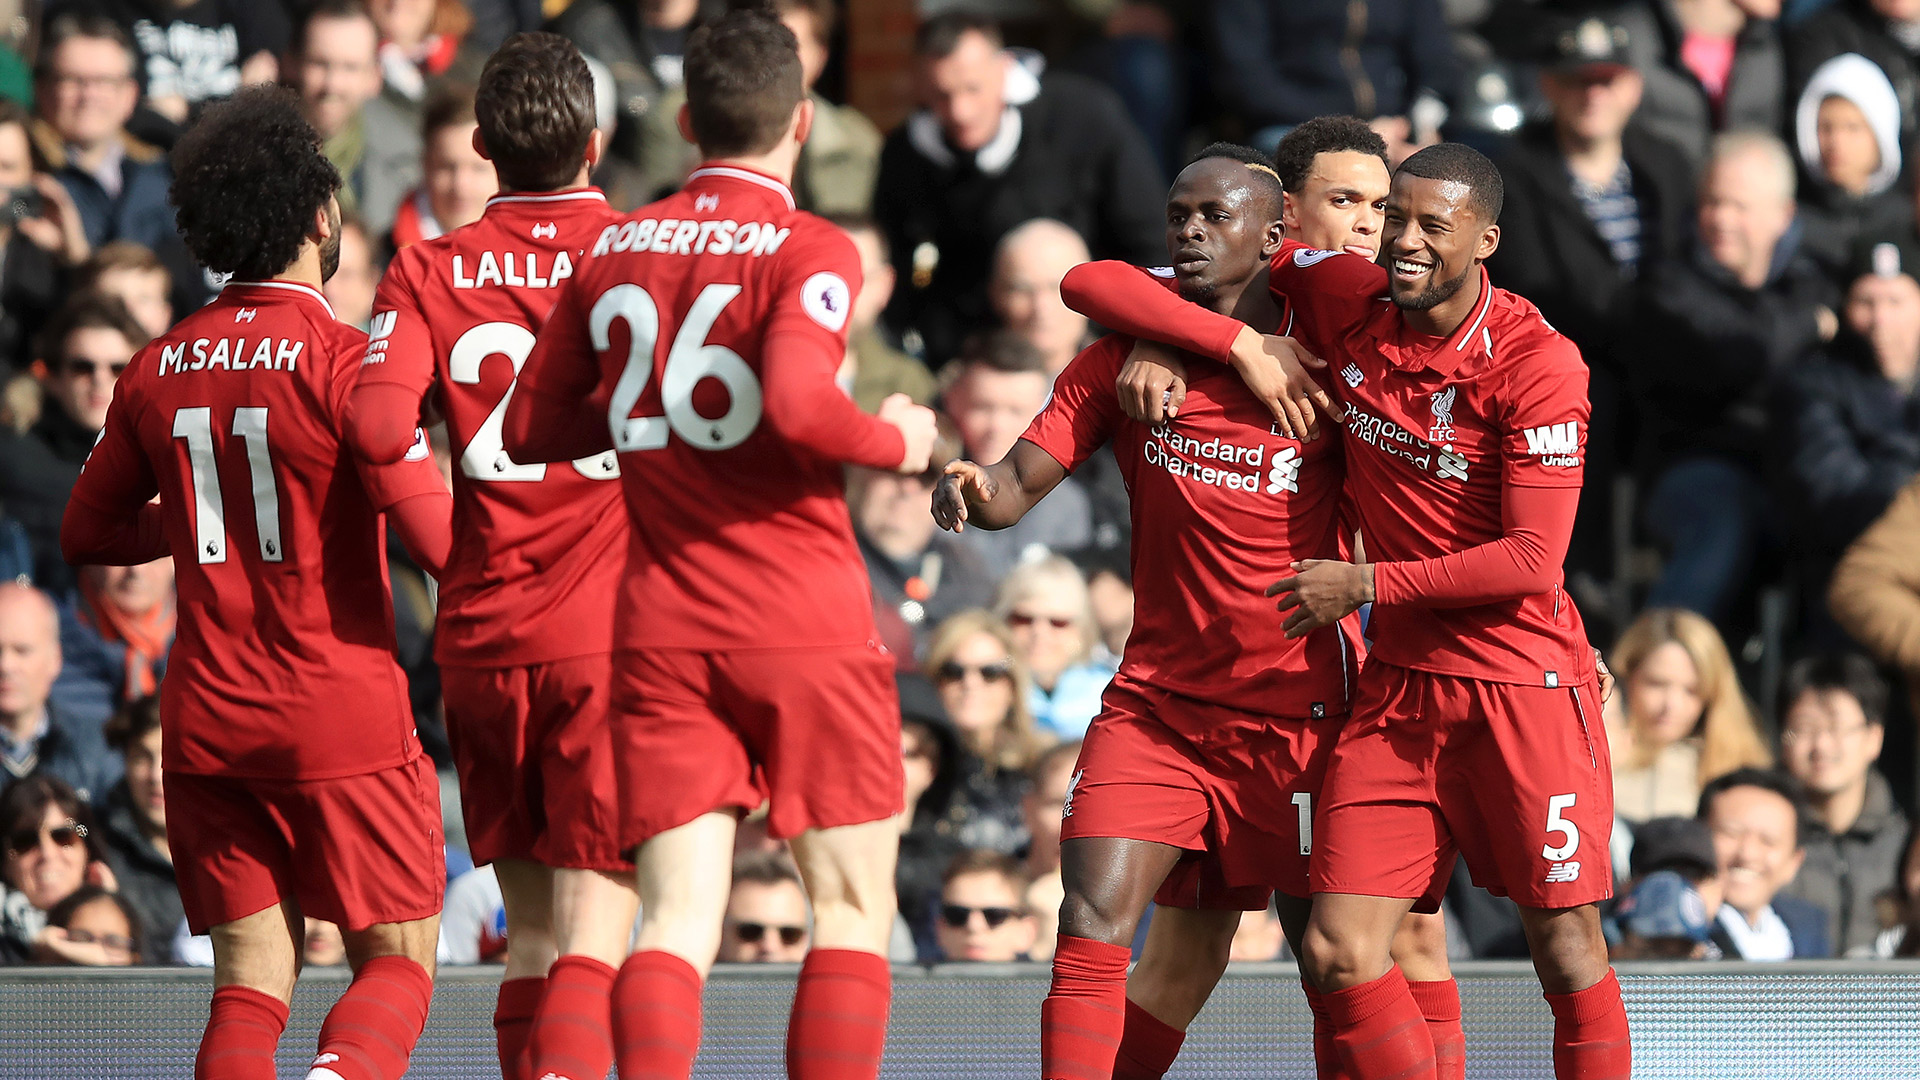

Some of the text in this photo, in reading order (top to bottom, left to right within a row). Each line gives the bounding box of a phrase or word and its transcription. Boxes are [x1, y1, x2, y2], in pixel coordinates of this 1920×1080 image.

[591, 218, 791, 257] ROBERTSON
[452, 250, 584, 289] LALLA
[158, 337, 304, 377] M.SALAH
[589, 283, 763, 452] 26
[1428, 429, 1458, 442] L.F.C.
[1144, 440, 1261, 493] Chartered
[1541, 454, 1580, 467] Union
[172, 406, 283, 564] 11
[1290, 792, 1313, 855] 1
[1541, 792, 1581, 862] 5
